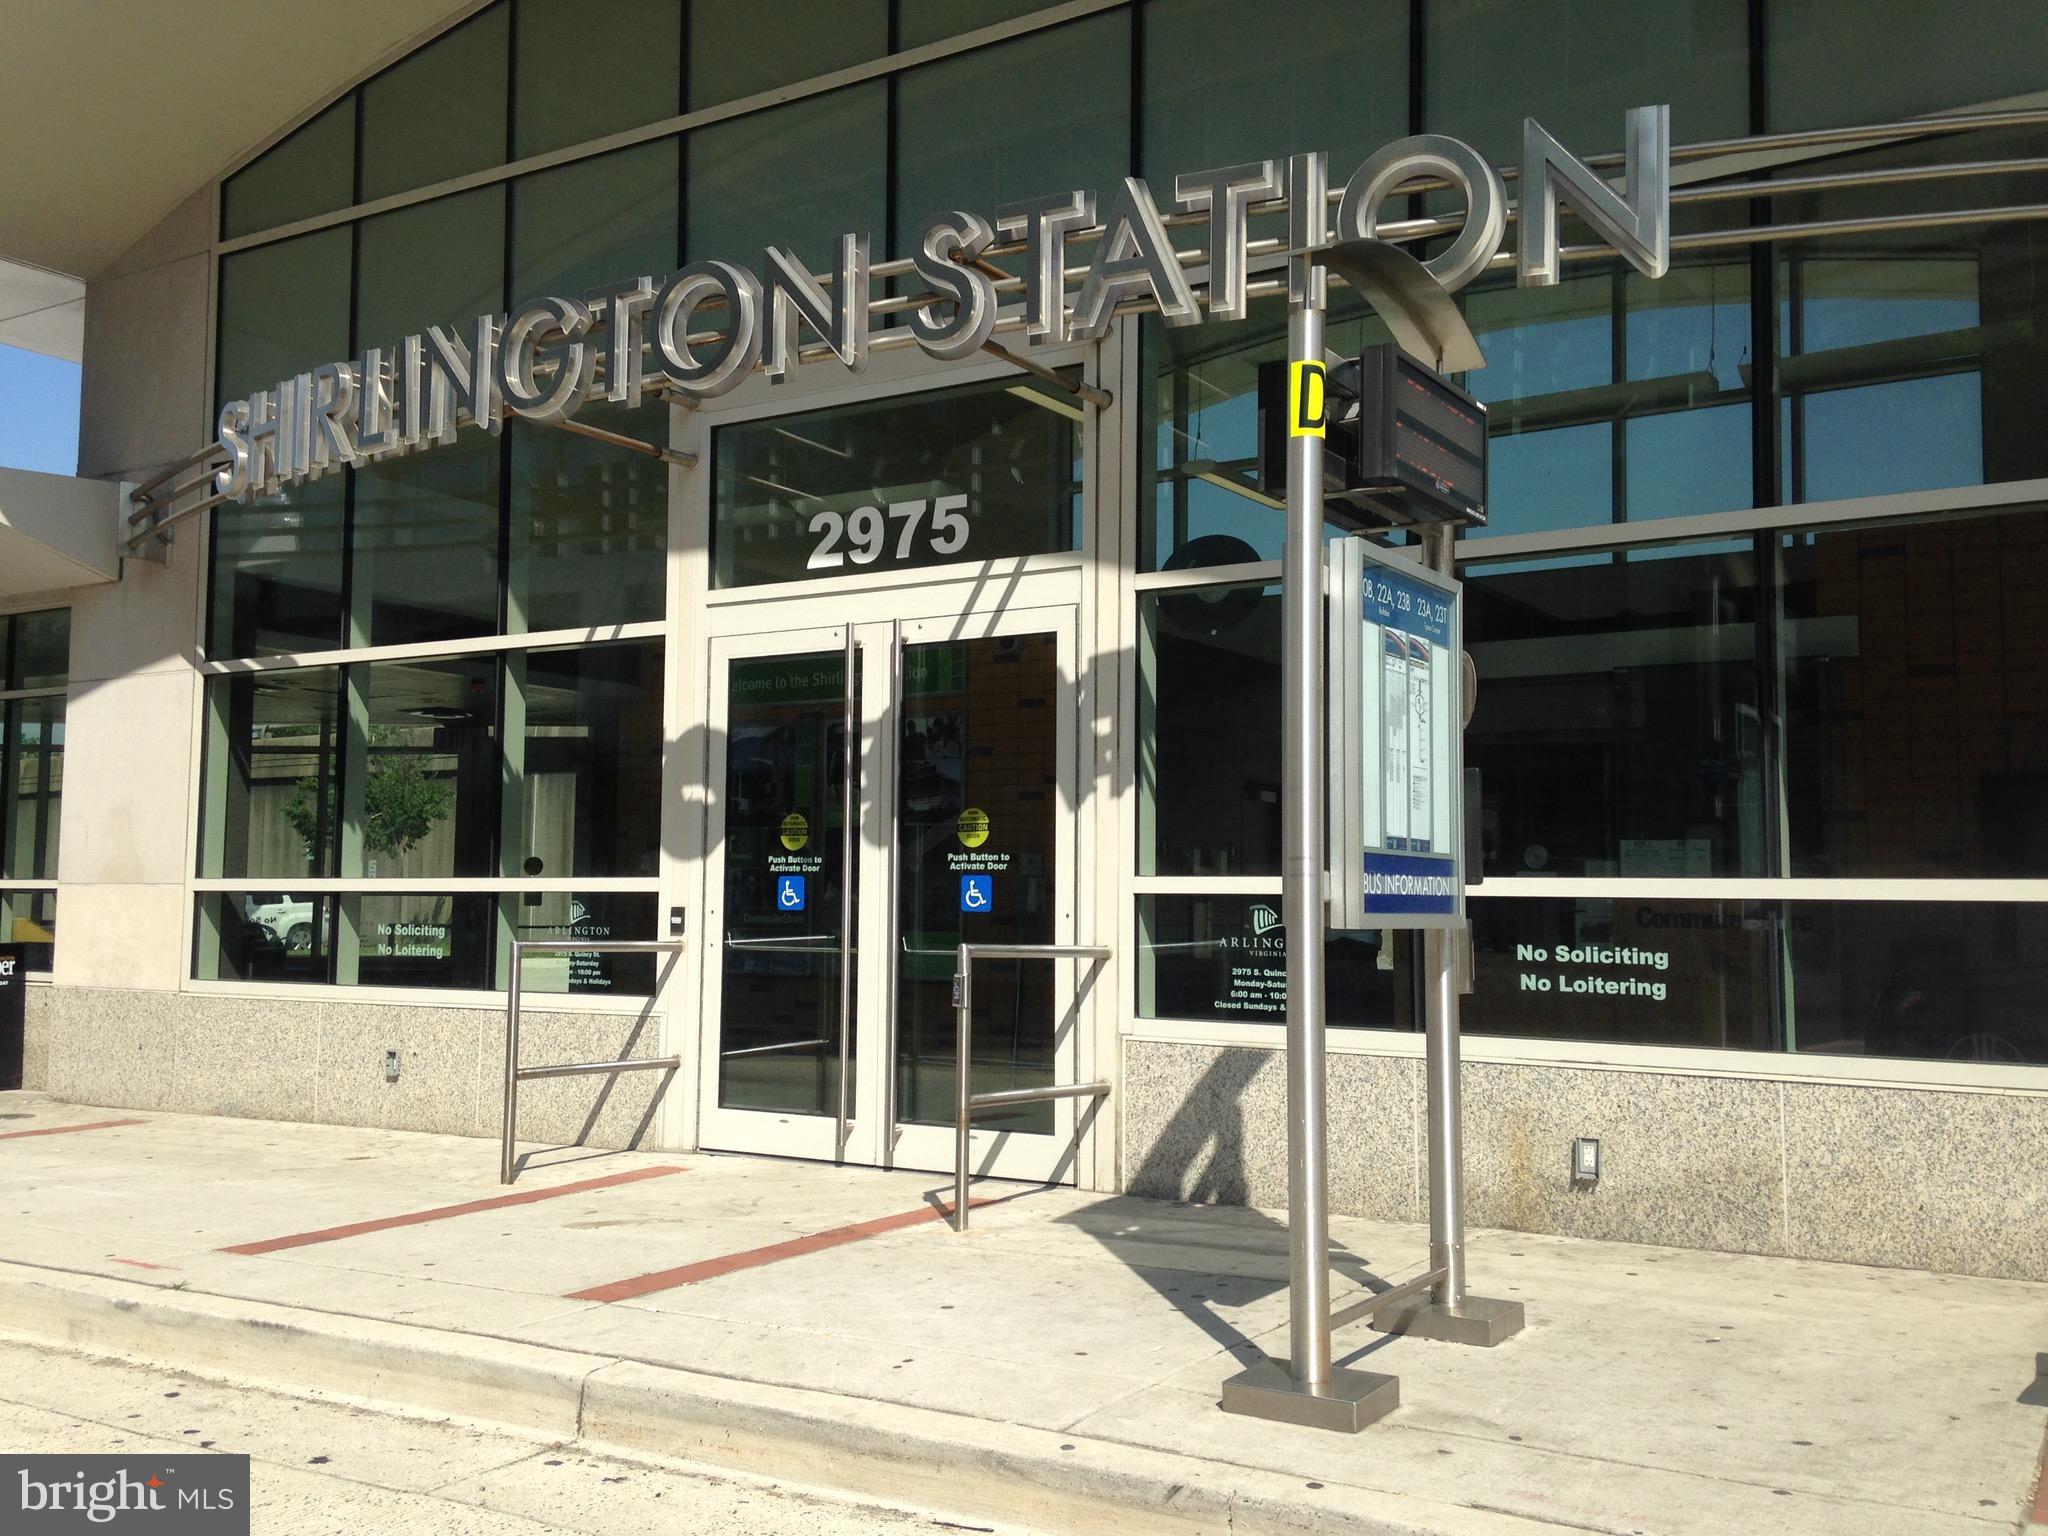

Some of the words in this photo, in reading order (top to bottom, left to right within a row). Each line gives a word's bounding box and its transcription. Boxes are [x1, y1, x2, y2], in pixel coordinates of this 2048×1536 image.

[215, 233, 870, 503] SHIRLINGTON
[909, 104, 1670, 360] STATION
[1299, 364, 1325, 428] D
[807, 494, 970, 570] 2975
[1377, 583, 1394, 610] 22A,
[1397, 591, 1411, 612] 23B
[732, 677, 772, 692] elcome
[947, 853, 968, 861] Push
[970, 853, 999, 861] Button
[950, 862, 985, 870] Activate
[987, 862, 1008, 870] Door
[1363, 873, 1382, 894] BUS
[1385, 874, 1451, 896] INFORMATION
[378, 924, 392, 935] No
[395, 924, 445, 939] Soliciting
[1219, 937, 1284, 949] ARLING
[378, 944, 392, 955] No
[395, 944, 443, 959] Loitering
[1517, 944, 1548, 962] No
[1555, 945, 1669, 970] Soliciting
[1231, 968, 1252, 976] 2975
[1234, 979, 1287, 989] Monday-Satu
[1520, 974, 1551, 991] No
[1559, 975, 1667, 1000] Loitering
[1230, 990, 1248, 998] 6:00
[1214, 1001, 1241, 1009] Closed
[1244, 1002, 1277, 1012] Sundays
